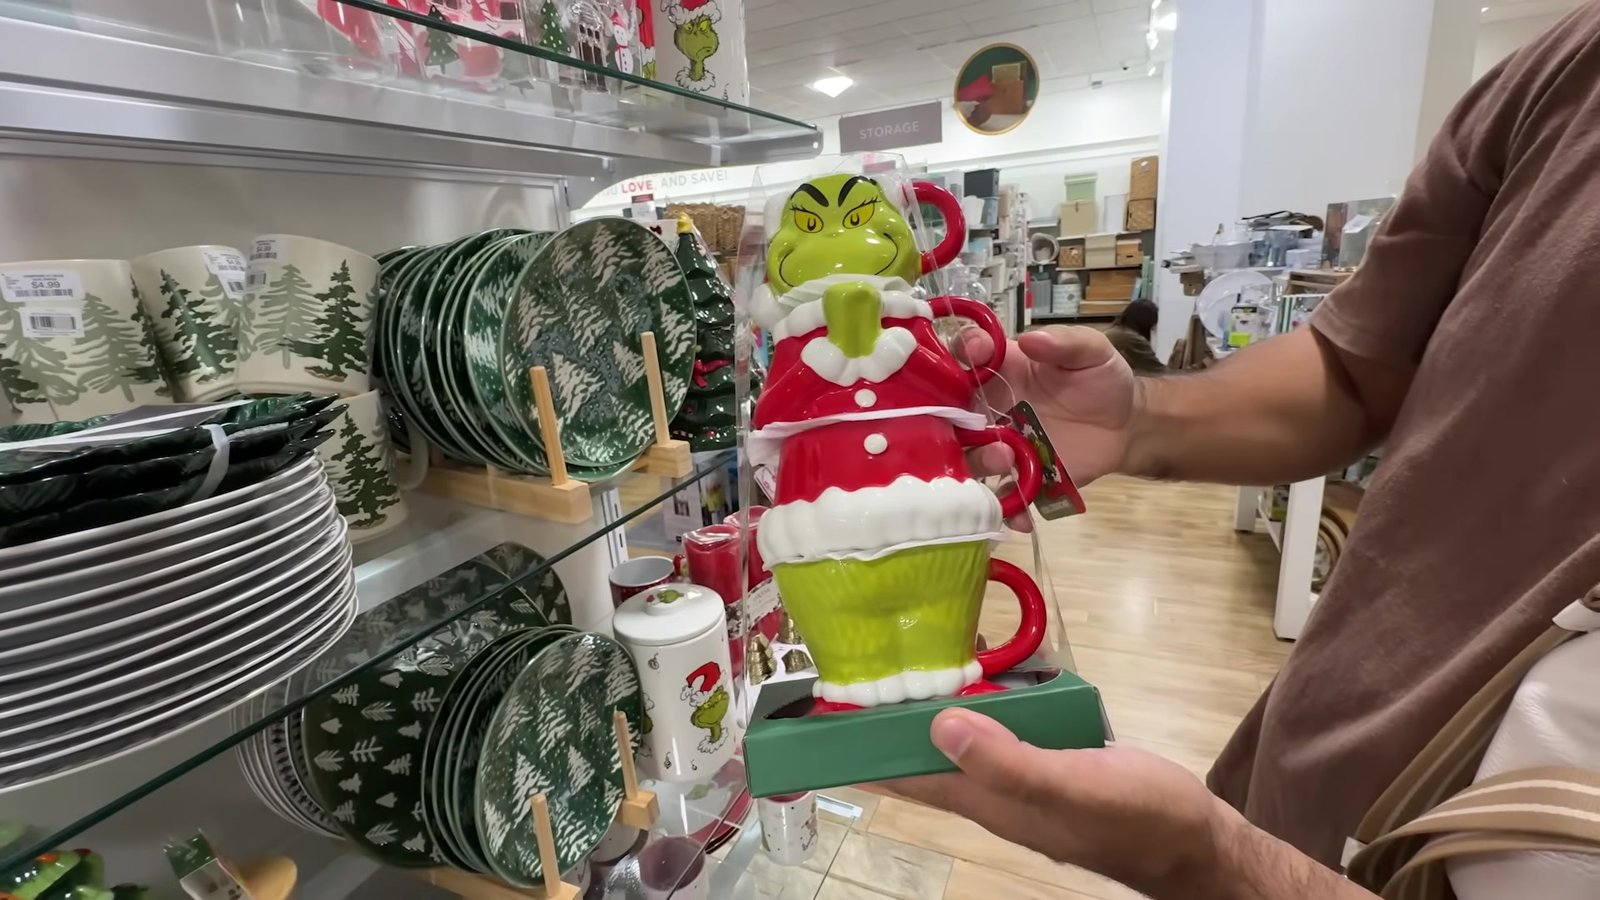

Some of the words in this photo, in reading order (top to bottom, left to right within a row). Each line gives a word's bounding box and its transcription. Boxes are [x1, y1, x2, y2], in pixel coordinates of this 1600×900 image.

[859, 120, 919, 140] STORAGE
[661, 174, 687, 188] AND
[691, 169, 728, 185] SAVE!
[31, 281, 61, 289] $4.99
